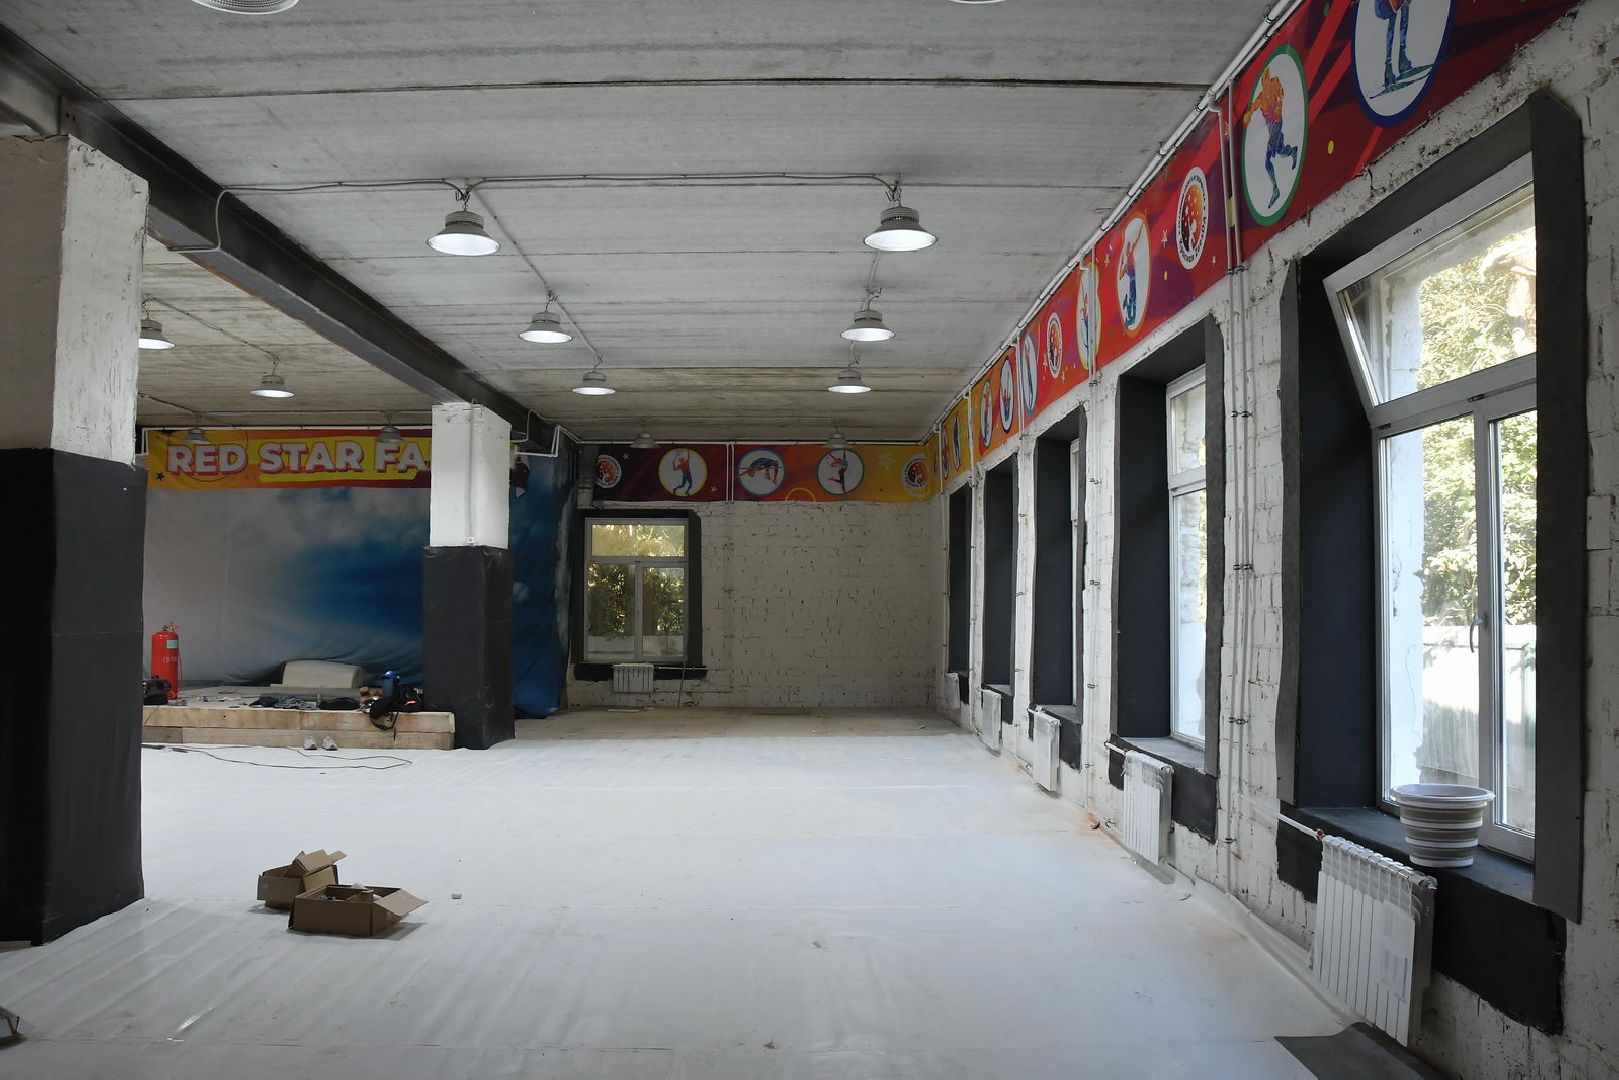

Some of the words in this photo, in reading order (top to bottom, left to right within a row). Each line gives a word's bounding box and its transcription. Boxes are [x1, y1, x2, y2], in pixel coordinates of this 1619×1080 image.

[167, 442, 249, 475] RED
[259, 441, 364, 475] STAR
[375, 441, 431, 474] FA
